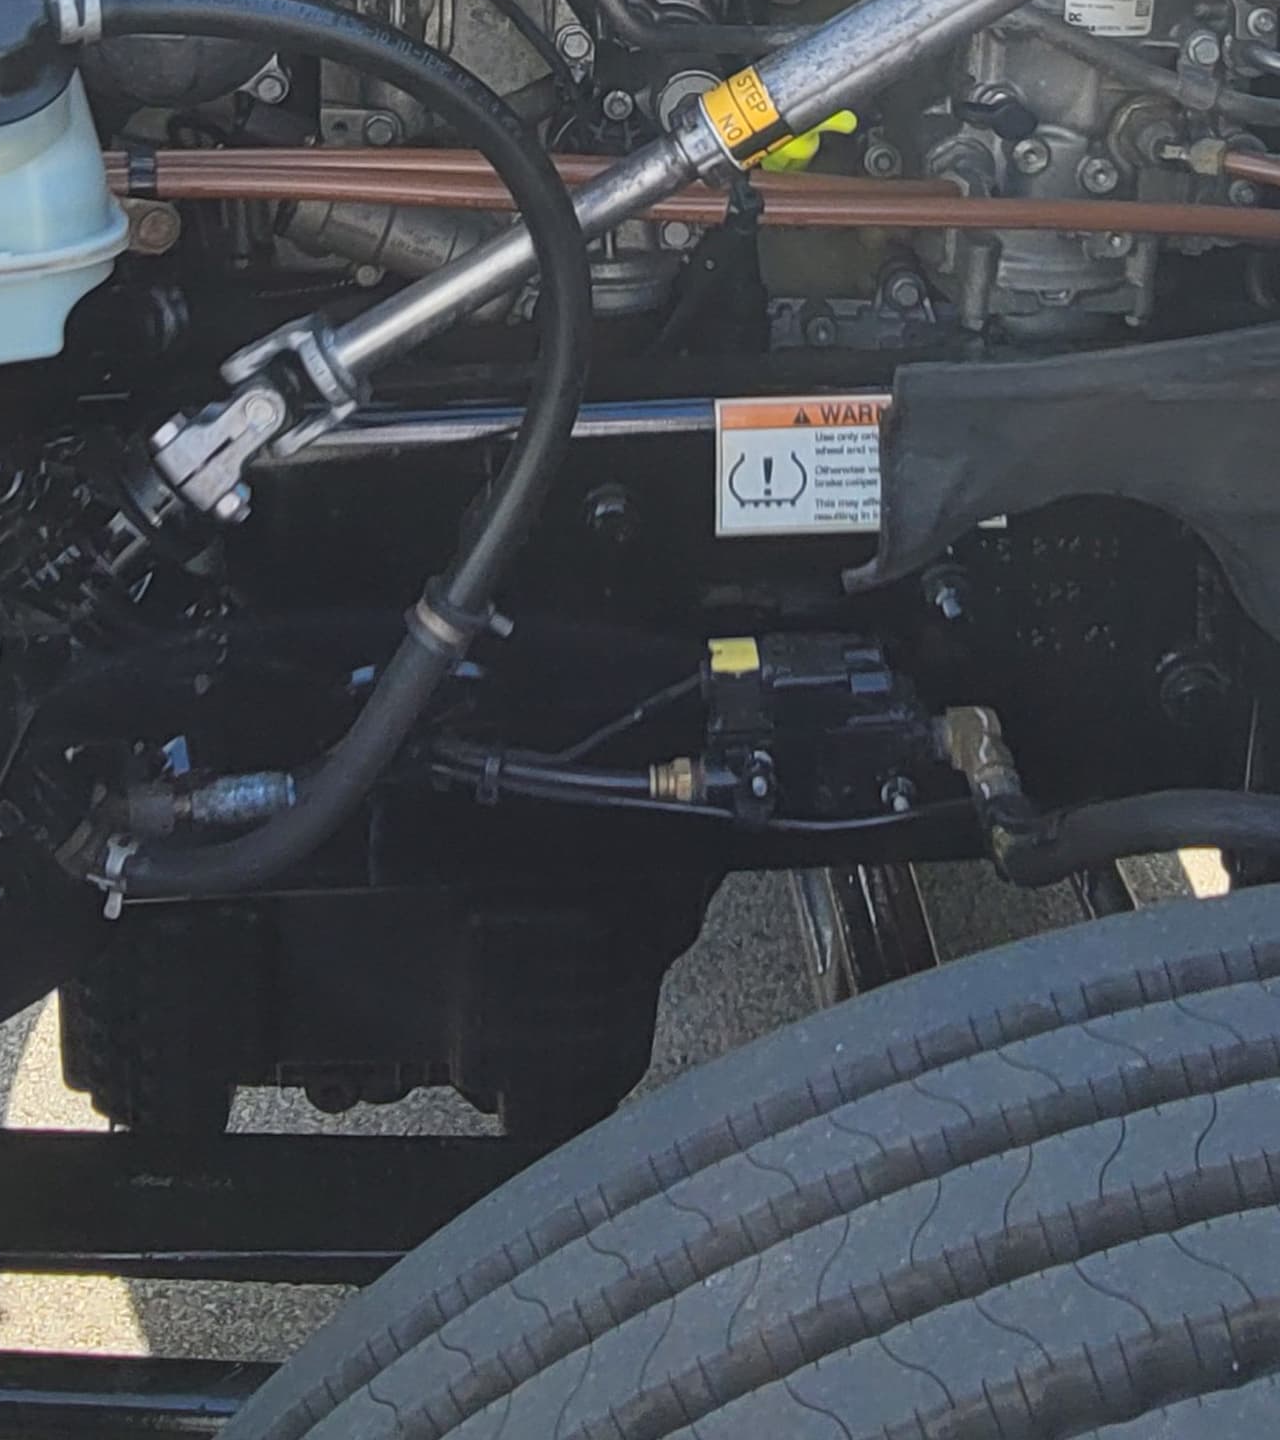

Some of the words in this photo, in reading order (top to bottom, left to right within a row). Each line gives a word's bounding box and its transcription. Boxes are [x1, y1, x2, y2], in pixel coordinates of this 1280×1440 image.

[736, 74, 768, 114] STEP
[719, 113, 744, 142] NO
[846, 445, 866, 454] and
[815, 497, 835, 508] This
